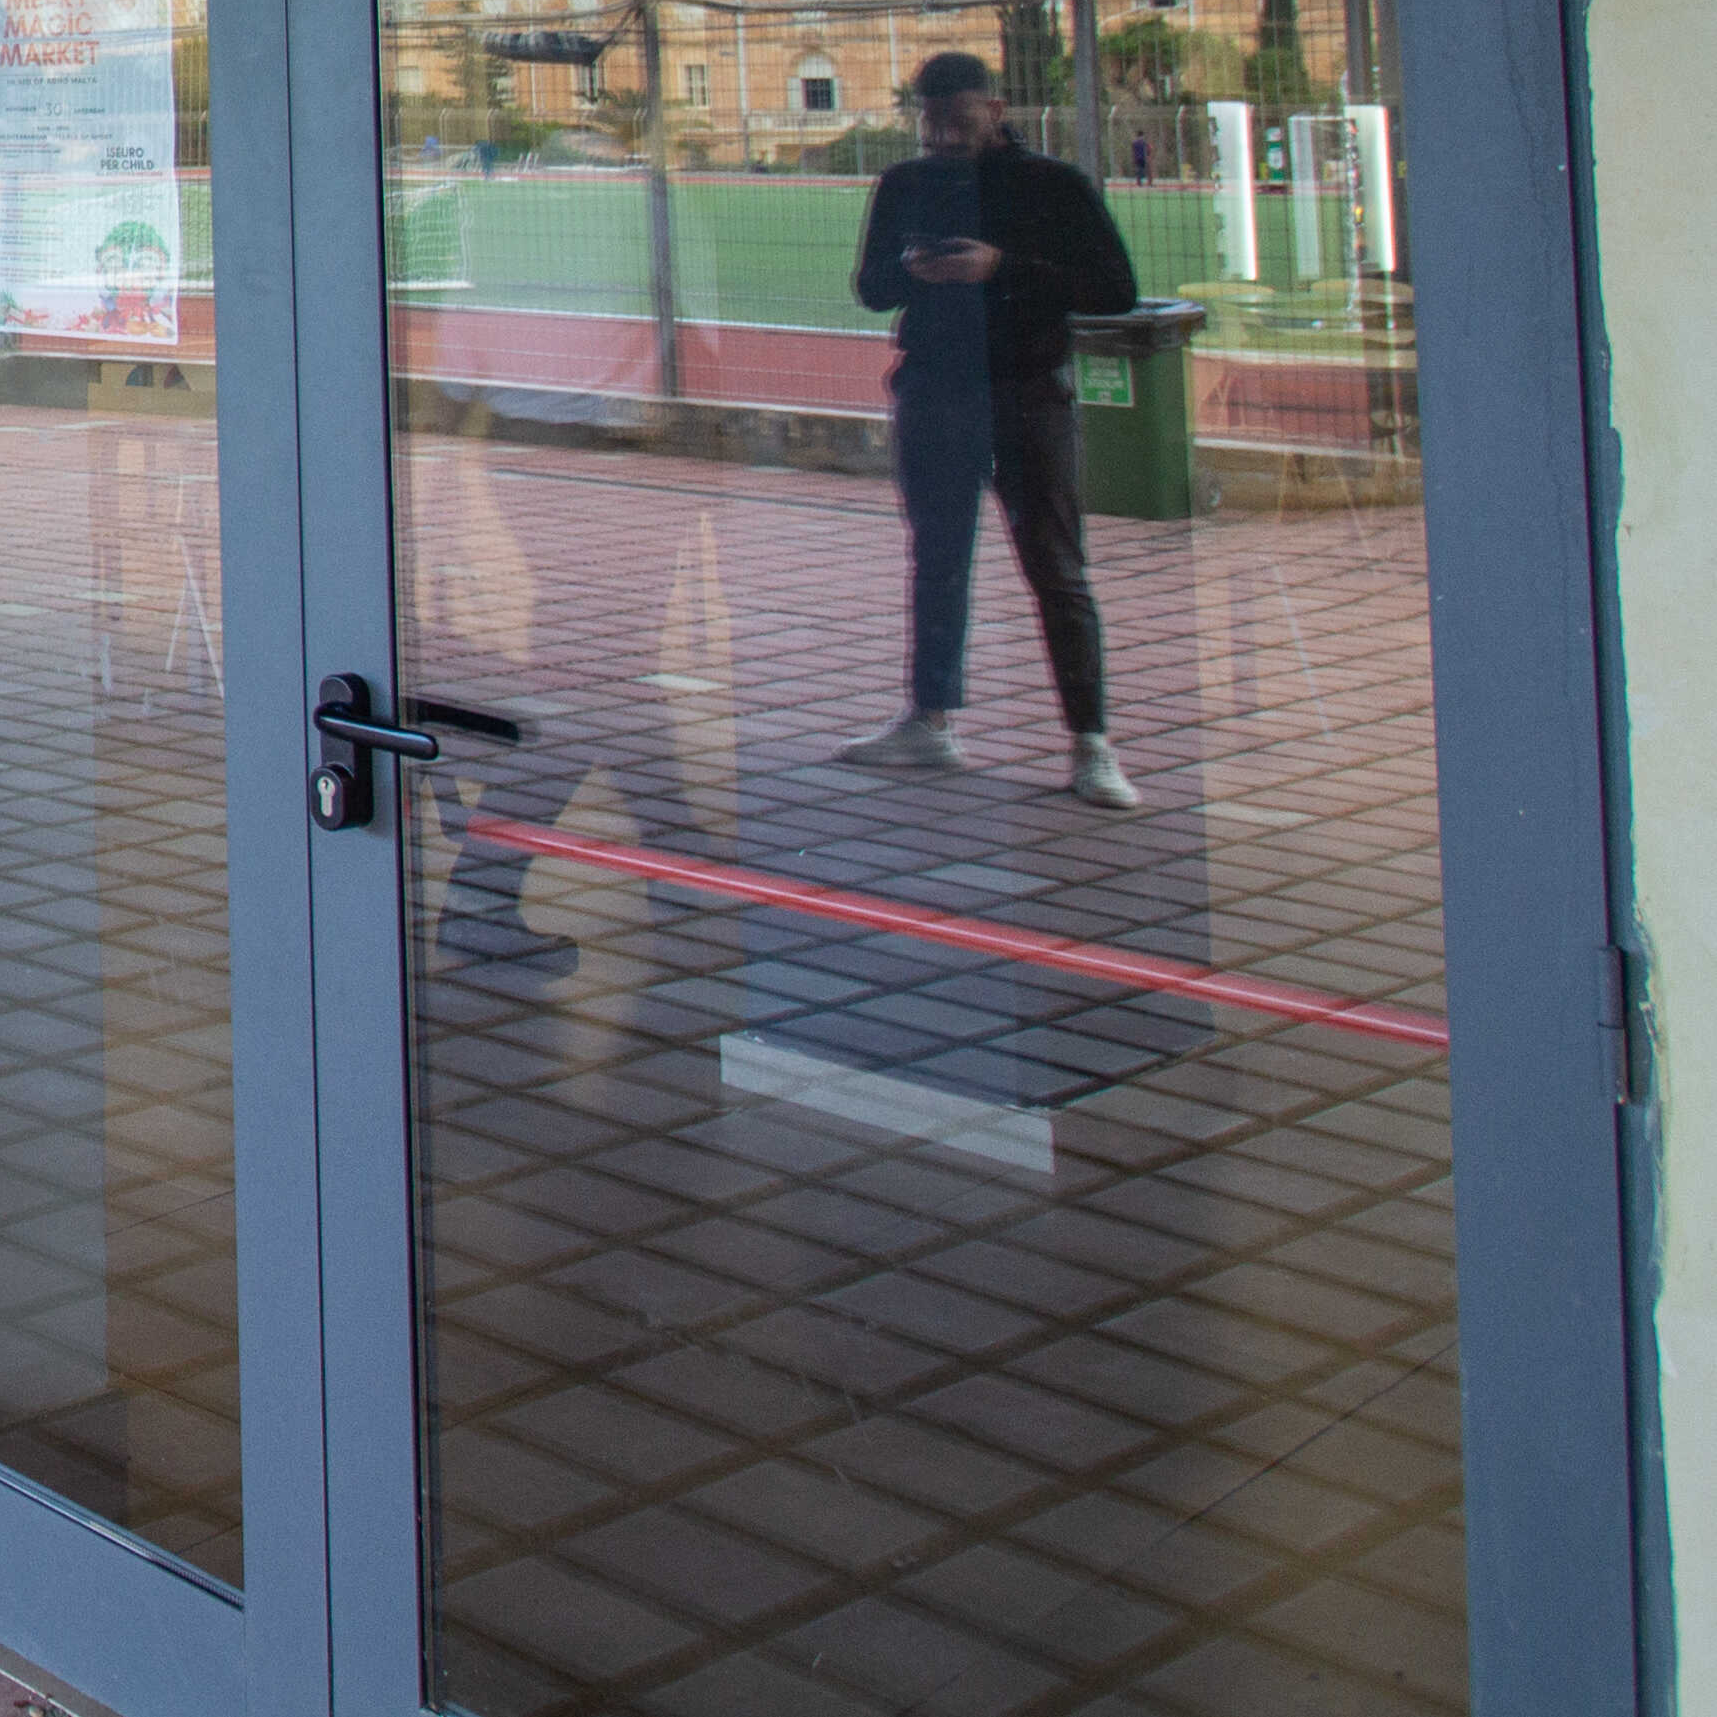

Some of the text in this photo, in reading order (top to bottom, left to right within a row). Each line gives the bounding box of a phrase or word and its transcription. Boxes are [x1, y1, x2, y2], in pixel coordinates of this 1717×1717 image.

[4, 12, 93, 39] MAGIC
[0, 40, 100, 68] MARKET
[100, 159, 155, 170] PER CHILD
